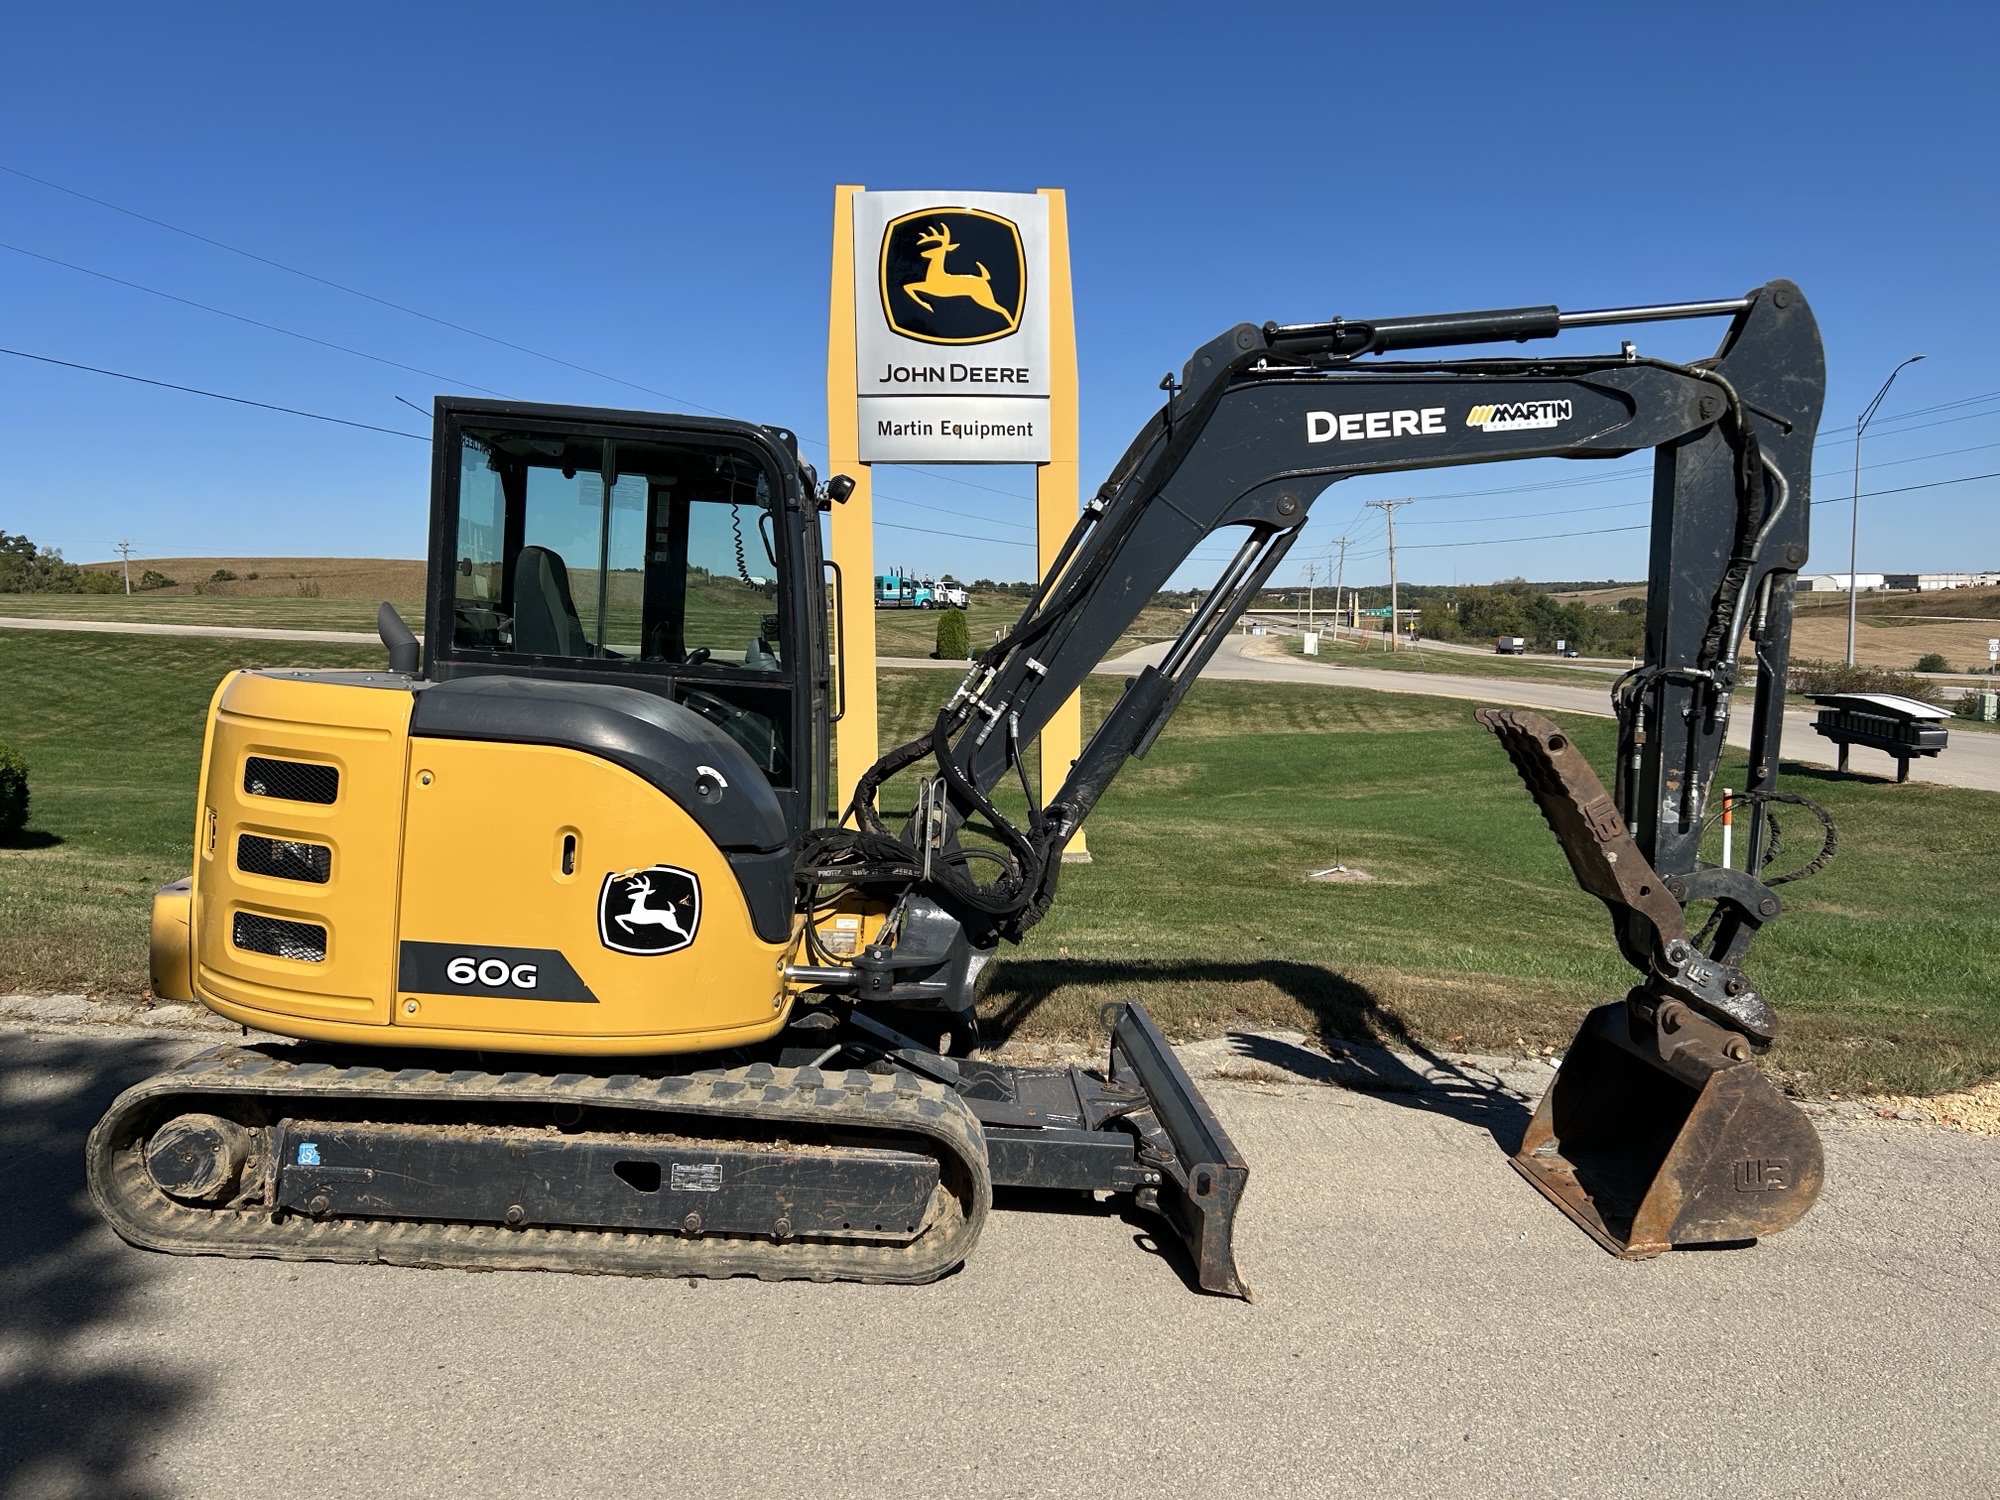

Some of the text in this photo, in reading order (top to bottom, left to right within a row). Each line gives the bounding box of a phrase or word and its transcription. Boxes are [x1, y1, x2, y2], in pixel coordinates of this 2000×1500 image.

[879, 363, 1029, 383] JOHN DEERE
[1490, 402, 1570, 422] MARTIN
[878, 420, 1033, 439] Martin Equipment
[1306, 407, 1446, 443] DEERE
[447, 957, 538, 989] 60G
